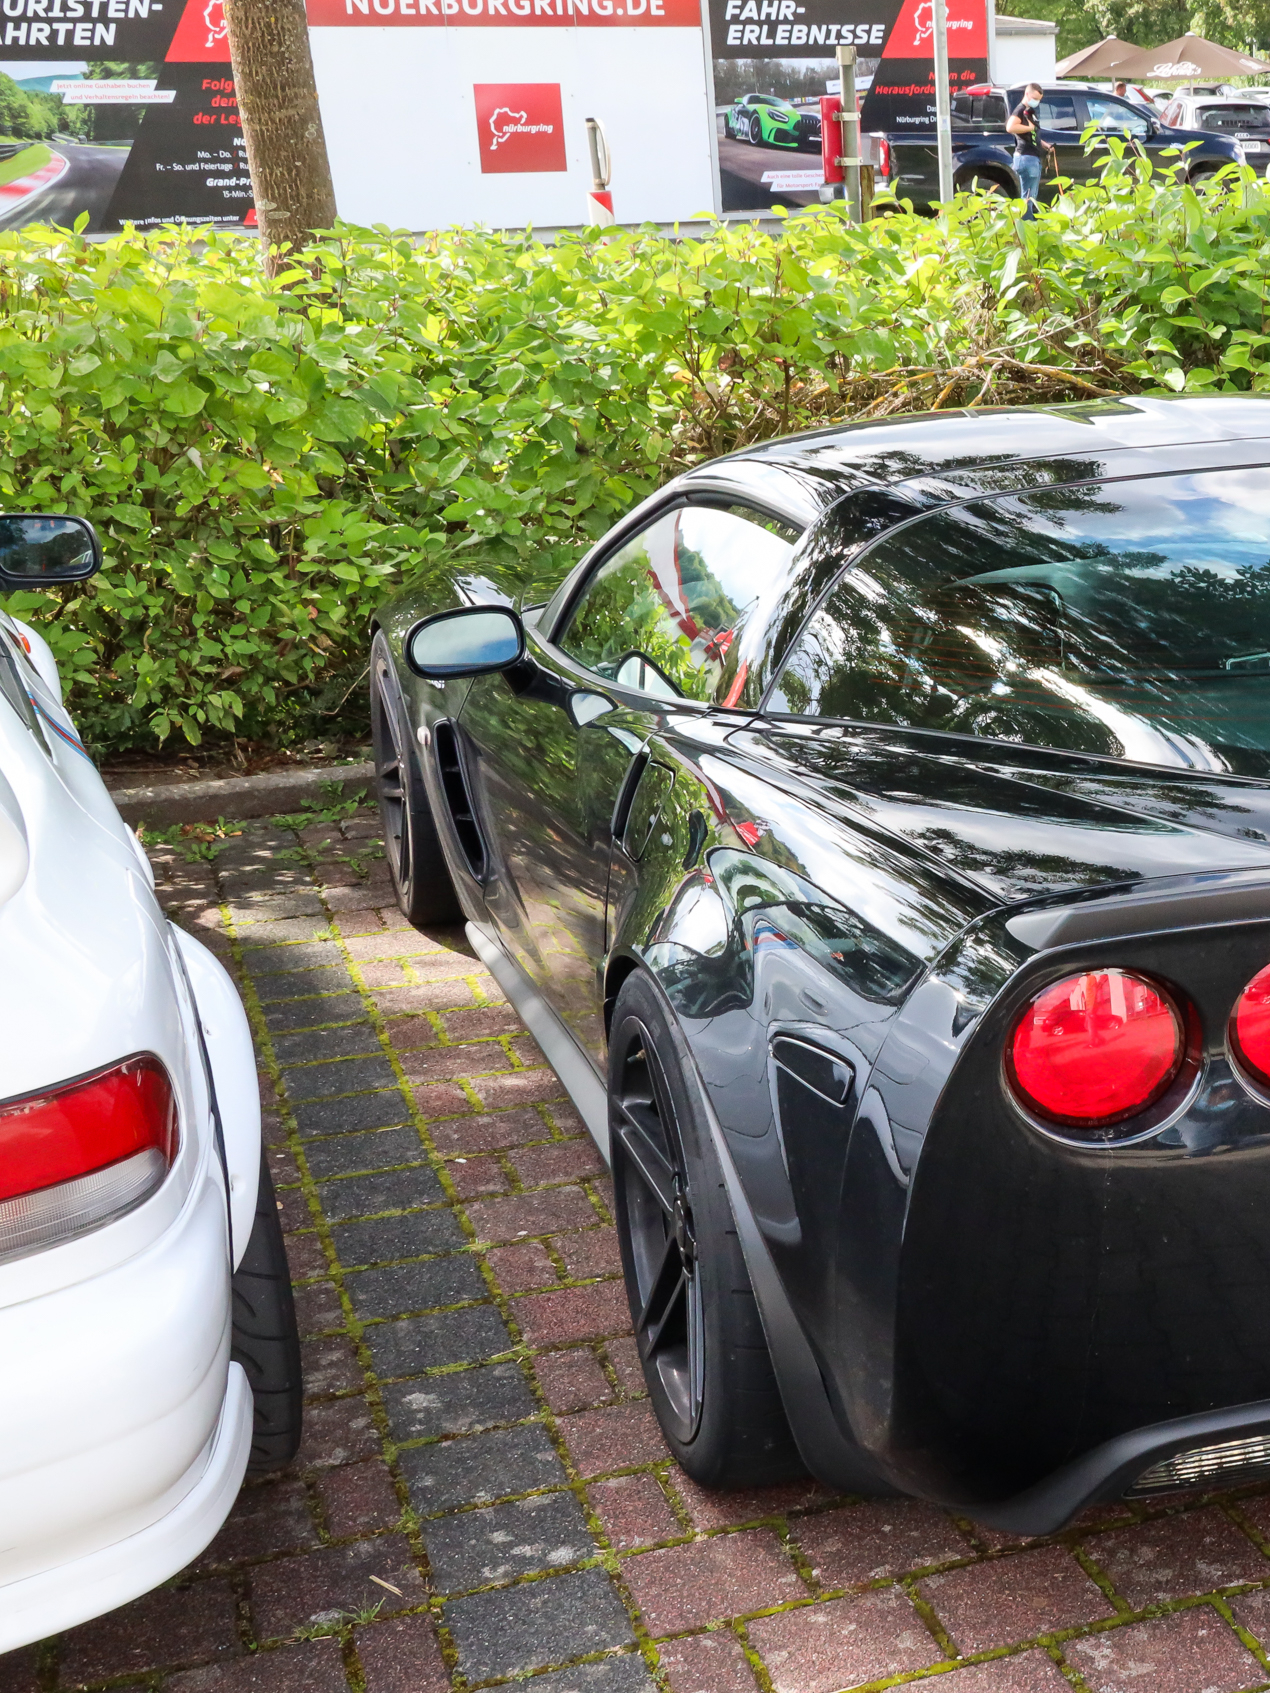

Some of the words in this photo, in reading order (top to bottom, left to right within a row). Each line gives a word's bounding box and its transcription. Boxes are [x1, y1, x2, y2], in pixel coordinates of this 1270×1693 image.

[345, 0, 665, 16] NUERBURGRING.DE
[725, 0, 805, 20] FAHR-
[0, 22, 116, 46] HRTEN
[726, 24, 886, 45] ERLEBNISSE
[960, 70, 976, 80] die
[202, 78, 235, 93] Folg
[193, 112, 217, 124] der
[896, 116, 929, 124] Nürburgring
[503, 124, 553, 134] nürburgring
[156, 163, 165, 171] Fr.
[173, 163, 184, 171] So.
[200, 162, 233, 171] Feiertage
